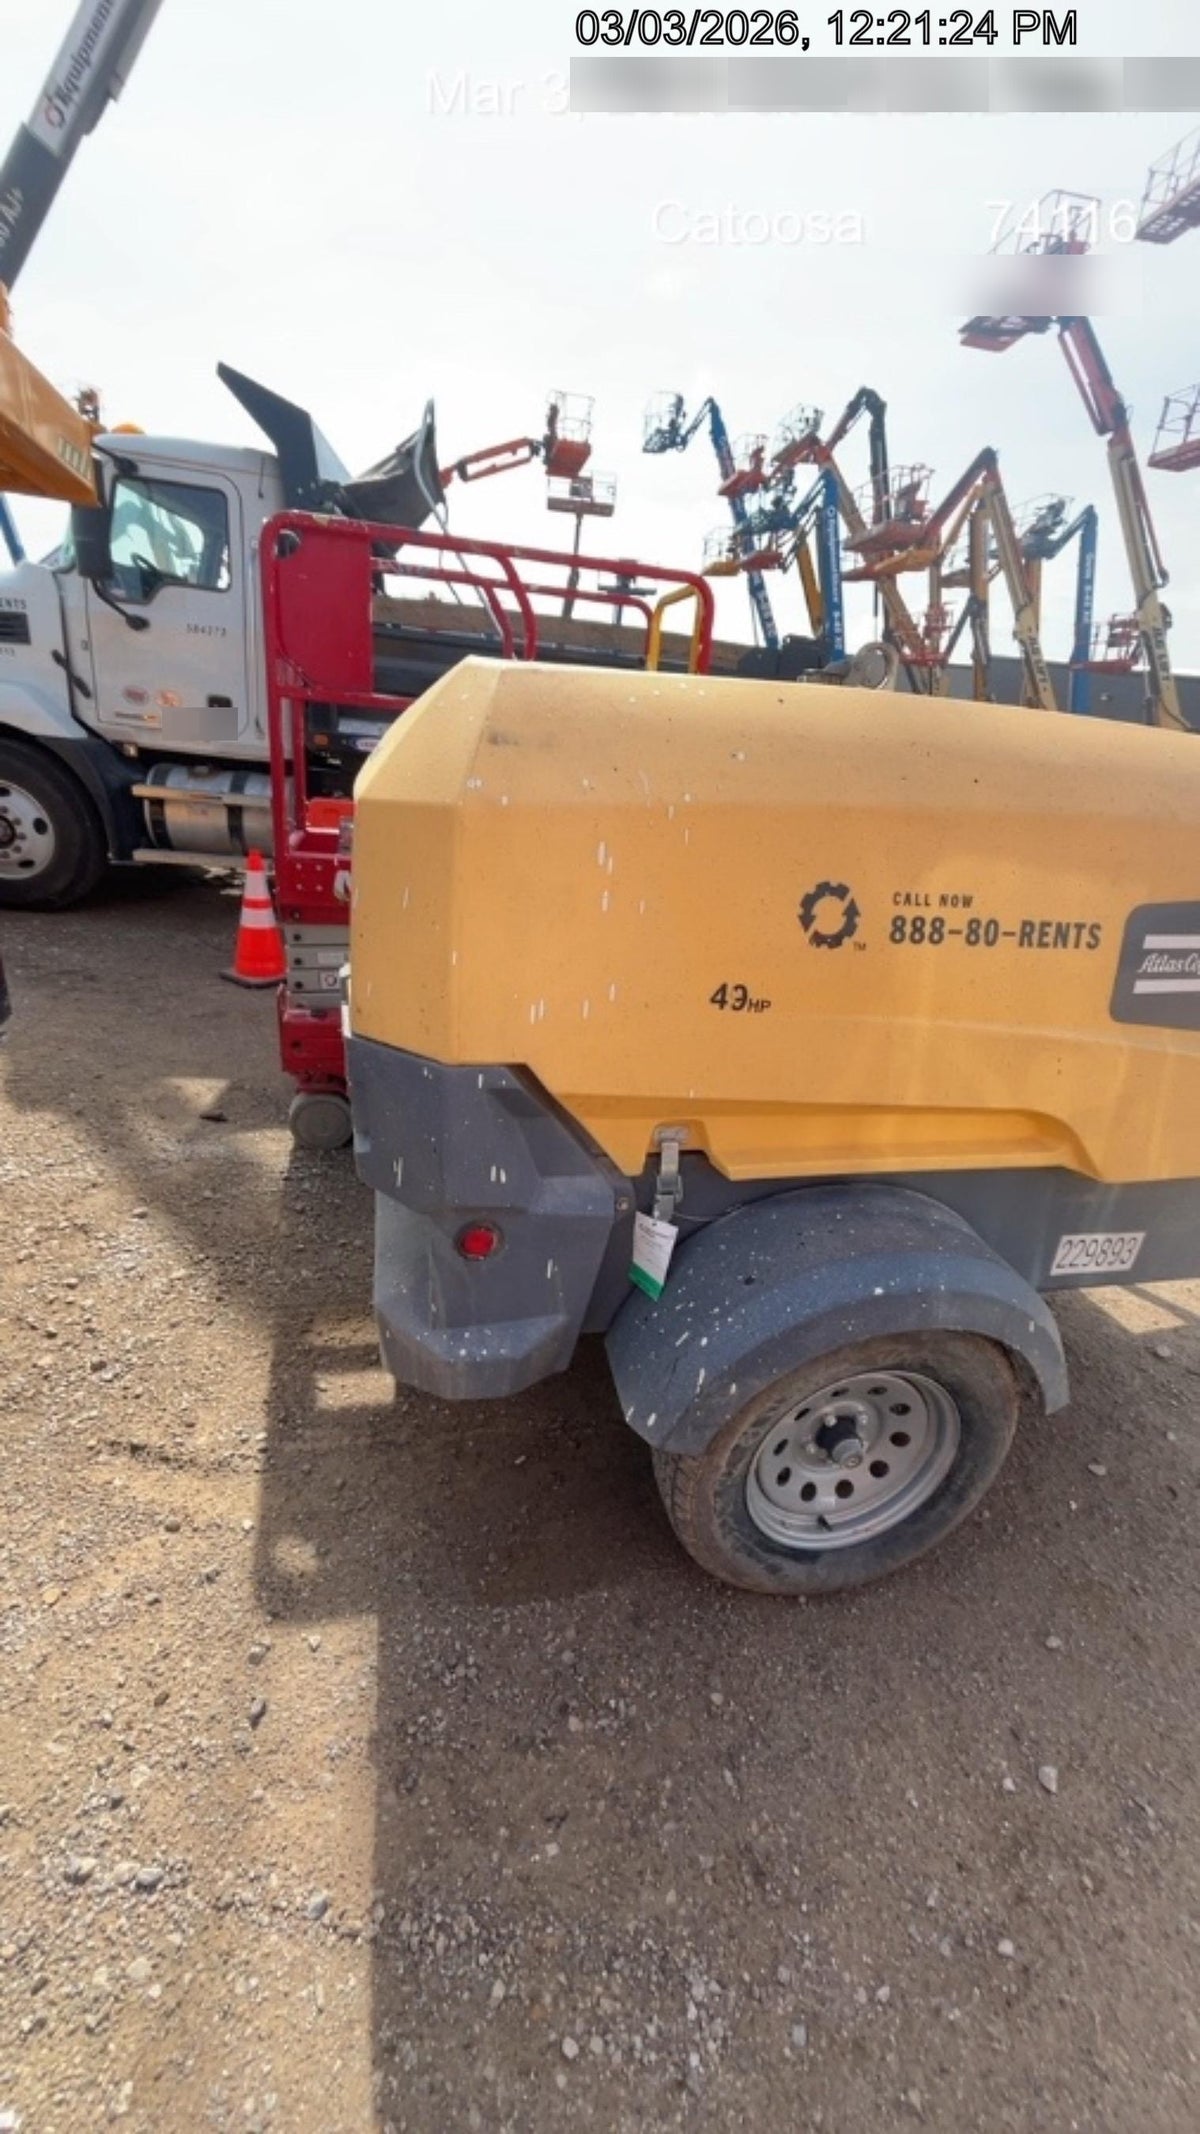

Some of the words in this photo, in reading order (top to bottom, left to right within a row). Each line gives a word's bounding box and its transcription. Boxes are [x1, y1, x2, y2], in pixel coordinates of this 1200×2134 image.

[893, 891, 931, 907] CALL
[939, 893, 974, 908] NOW
[889, 915, 1102, 950] 888-80-RENTS
[1055, 1236, 1137, 1269] 229893
